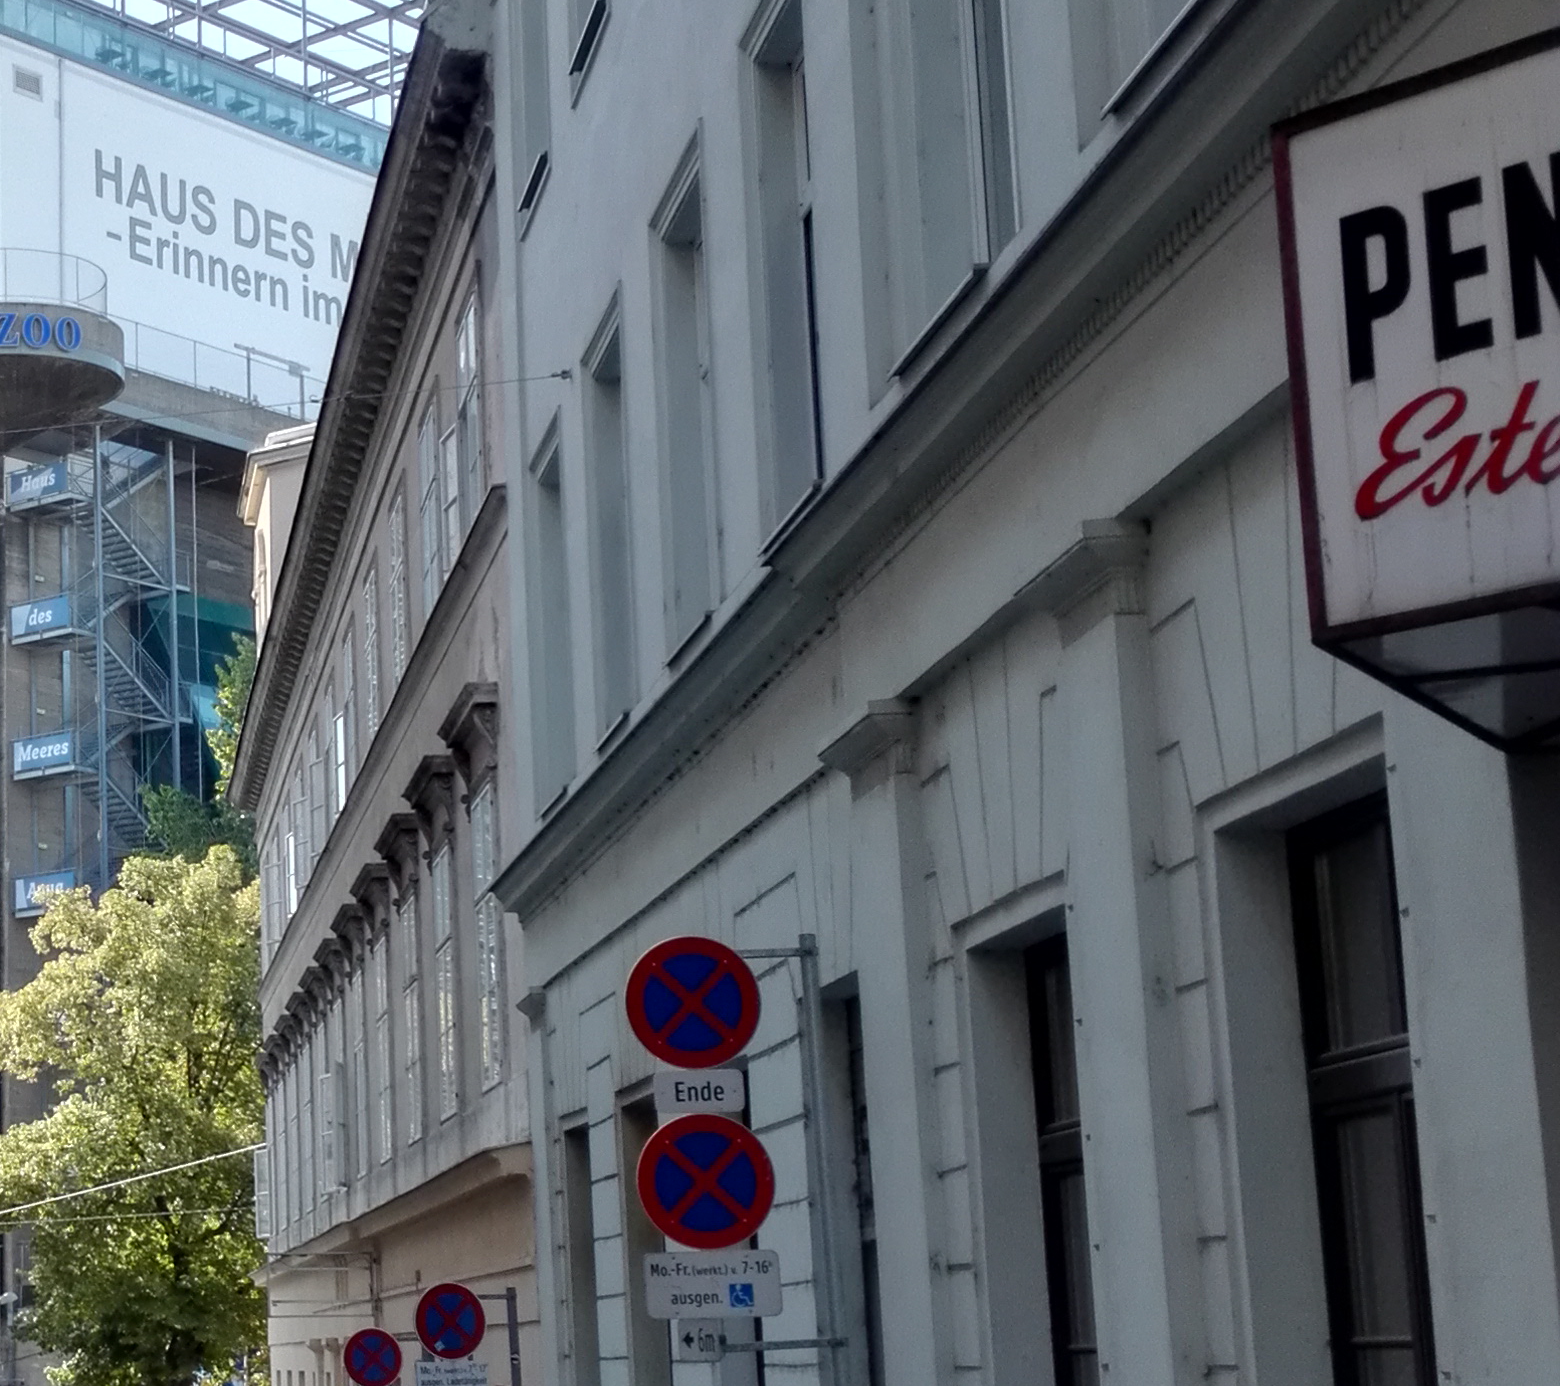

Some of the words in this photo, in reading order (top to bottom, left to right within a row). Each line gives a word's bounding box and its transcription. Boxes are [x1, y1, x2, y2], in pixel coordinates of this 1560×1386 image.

[94, 149, 217, 236] HAUS
[234, 198, 315, 269] DES
[21, 470, 57, 493] Haus
[29, 609, 53, 628] des
[17, 739, 69, 764] Meeres
[674, 1080, 726, 1103] Ende
[671, 1293, 724, 1308] ausgen.
[698, 1328, 716, 1353] 6m
